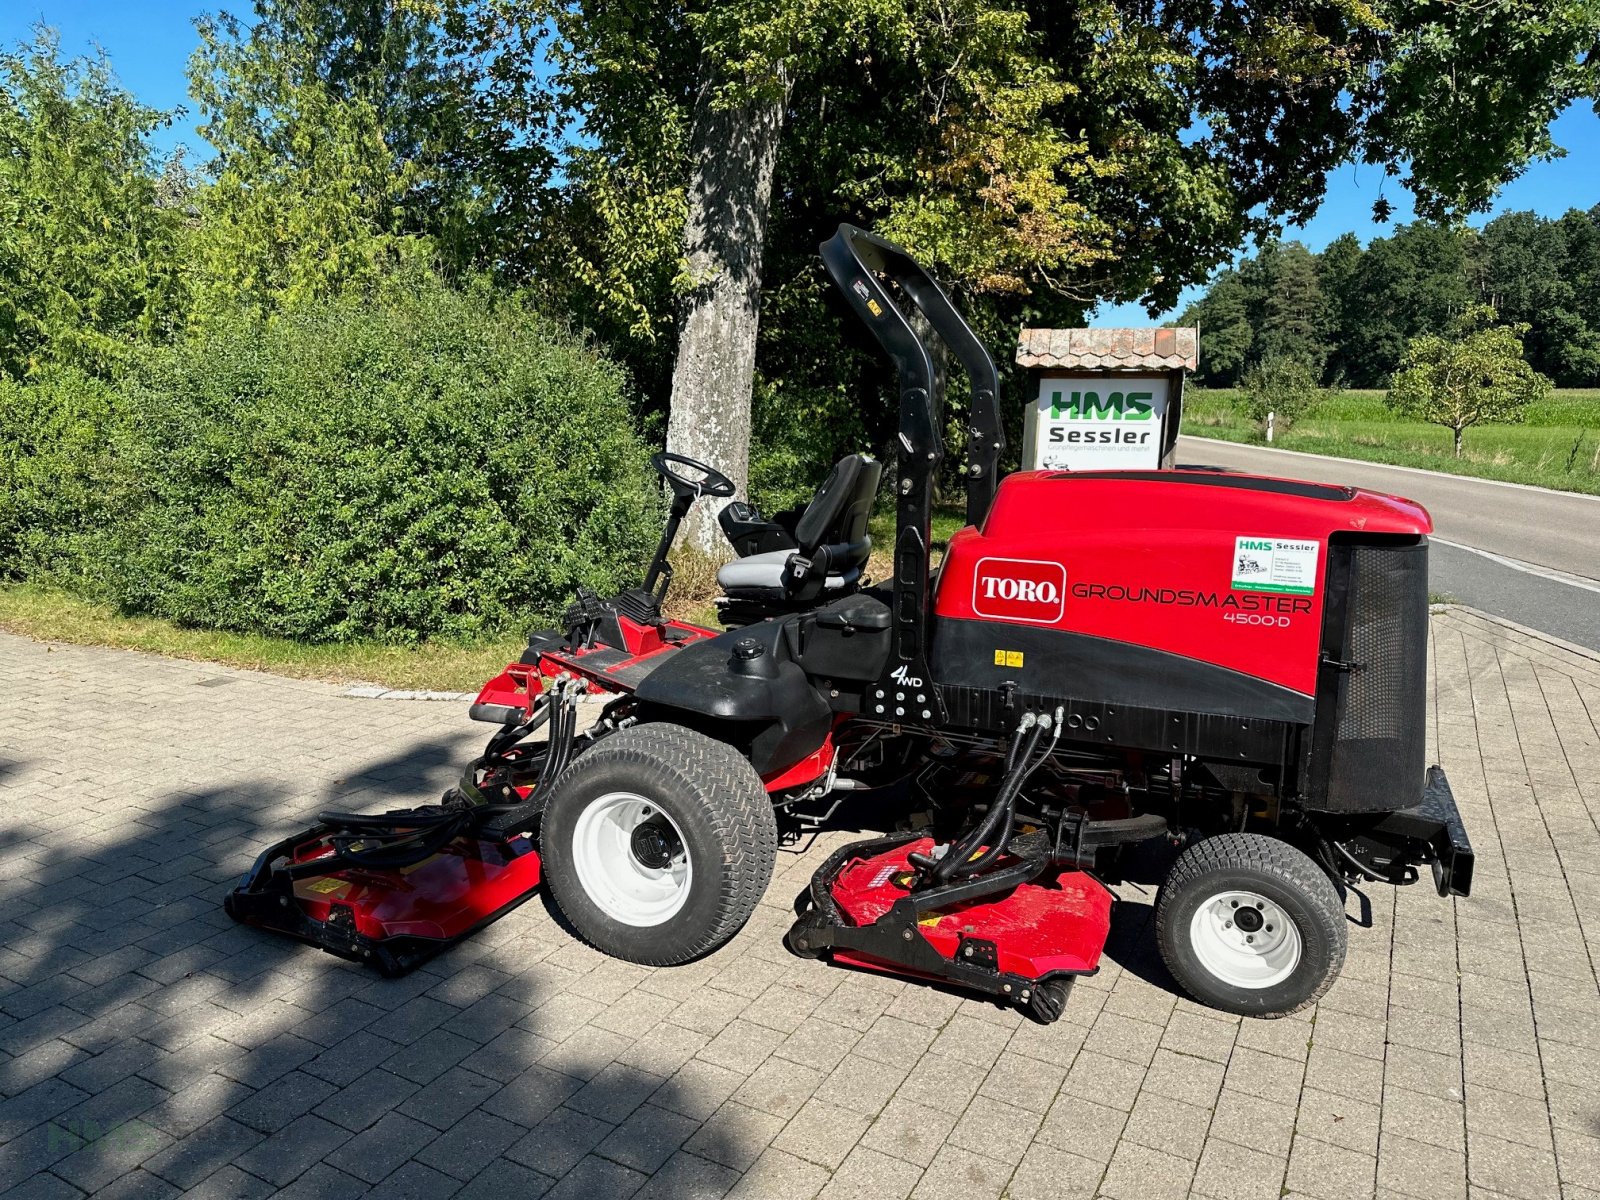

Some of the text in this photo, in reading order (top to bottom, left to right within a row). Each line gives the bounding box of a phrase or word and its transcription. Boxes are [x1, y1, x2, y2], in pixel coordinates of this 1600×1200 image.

[1051, 391, 1153, 420] HMS
[1049, 427, 1150, 444] Sessler
[1238, 540, 1273, 551] HMS
[1276, 542, 1315, 551] Sessler
[1071, 583, 1313, 614] GROUNDSMASTER
[890, 664, 923, 688] 4WD
